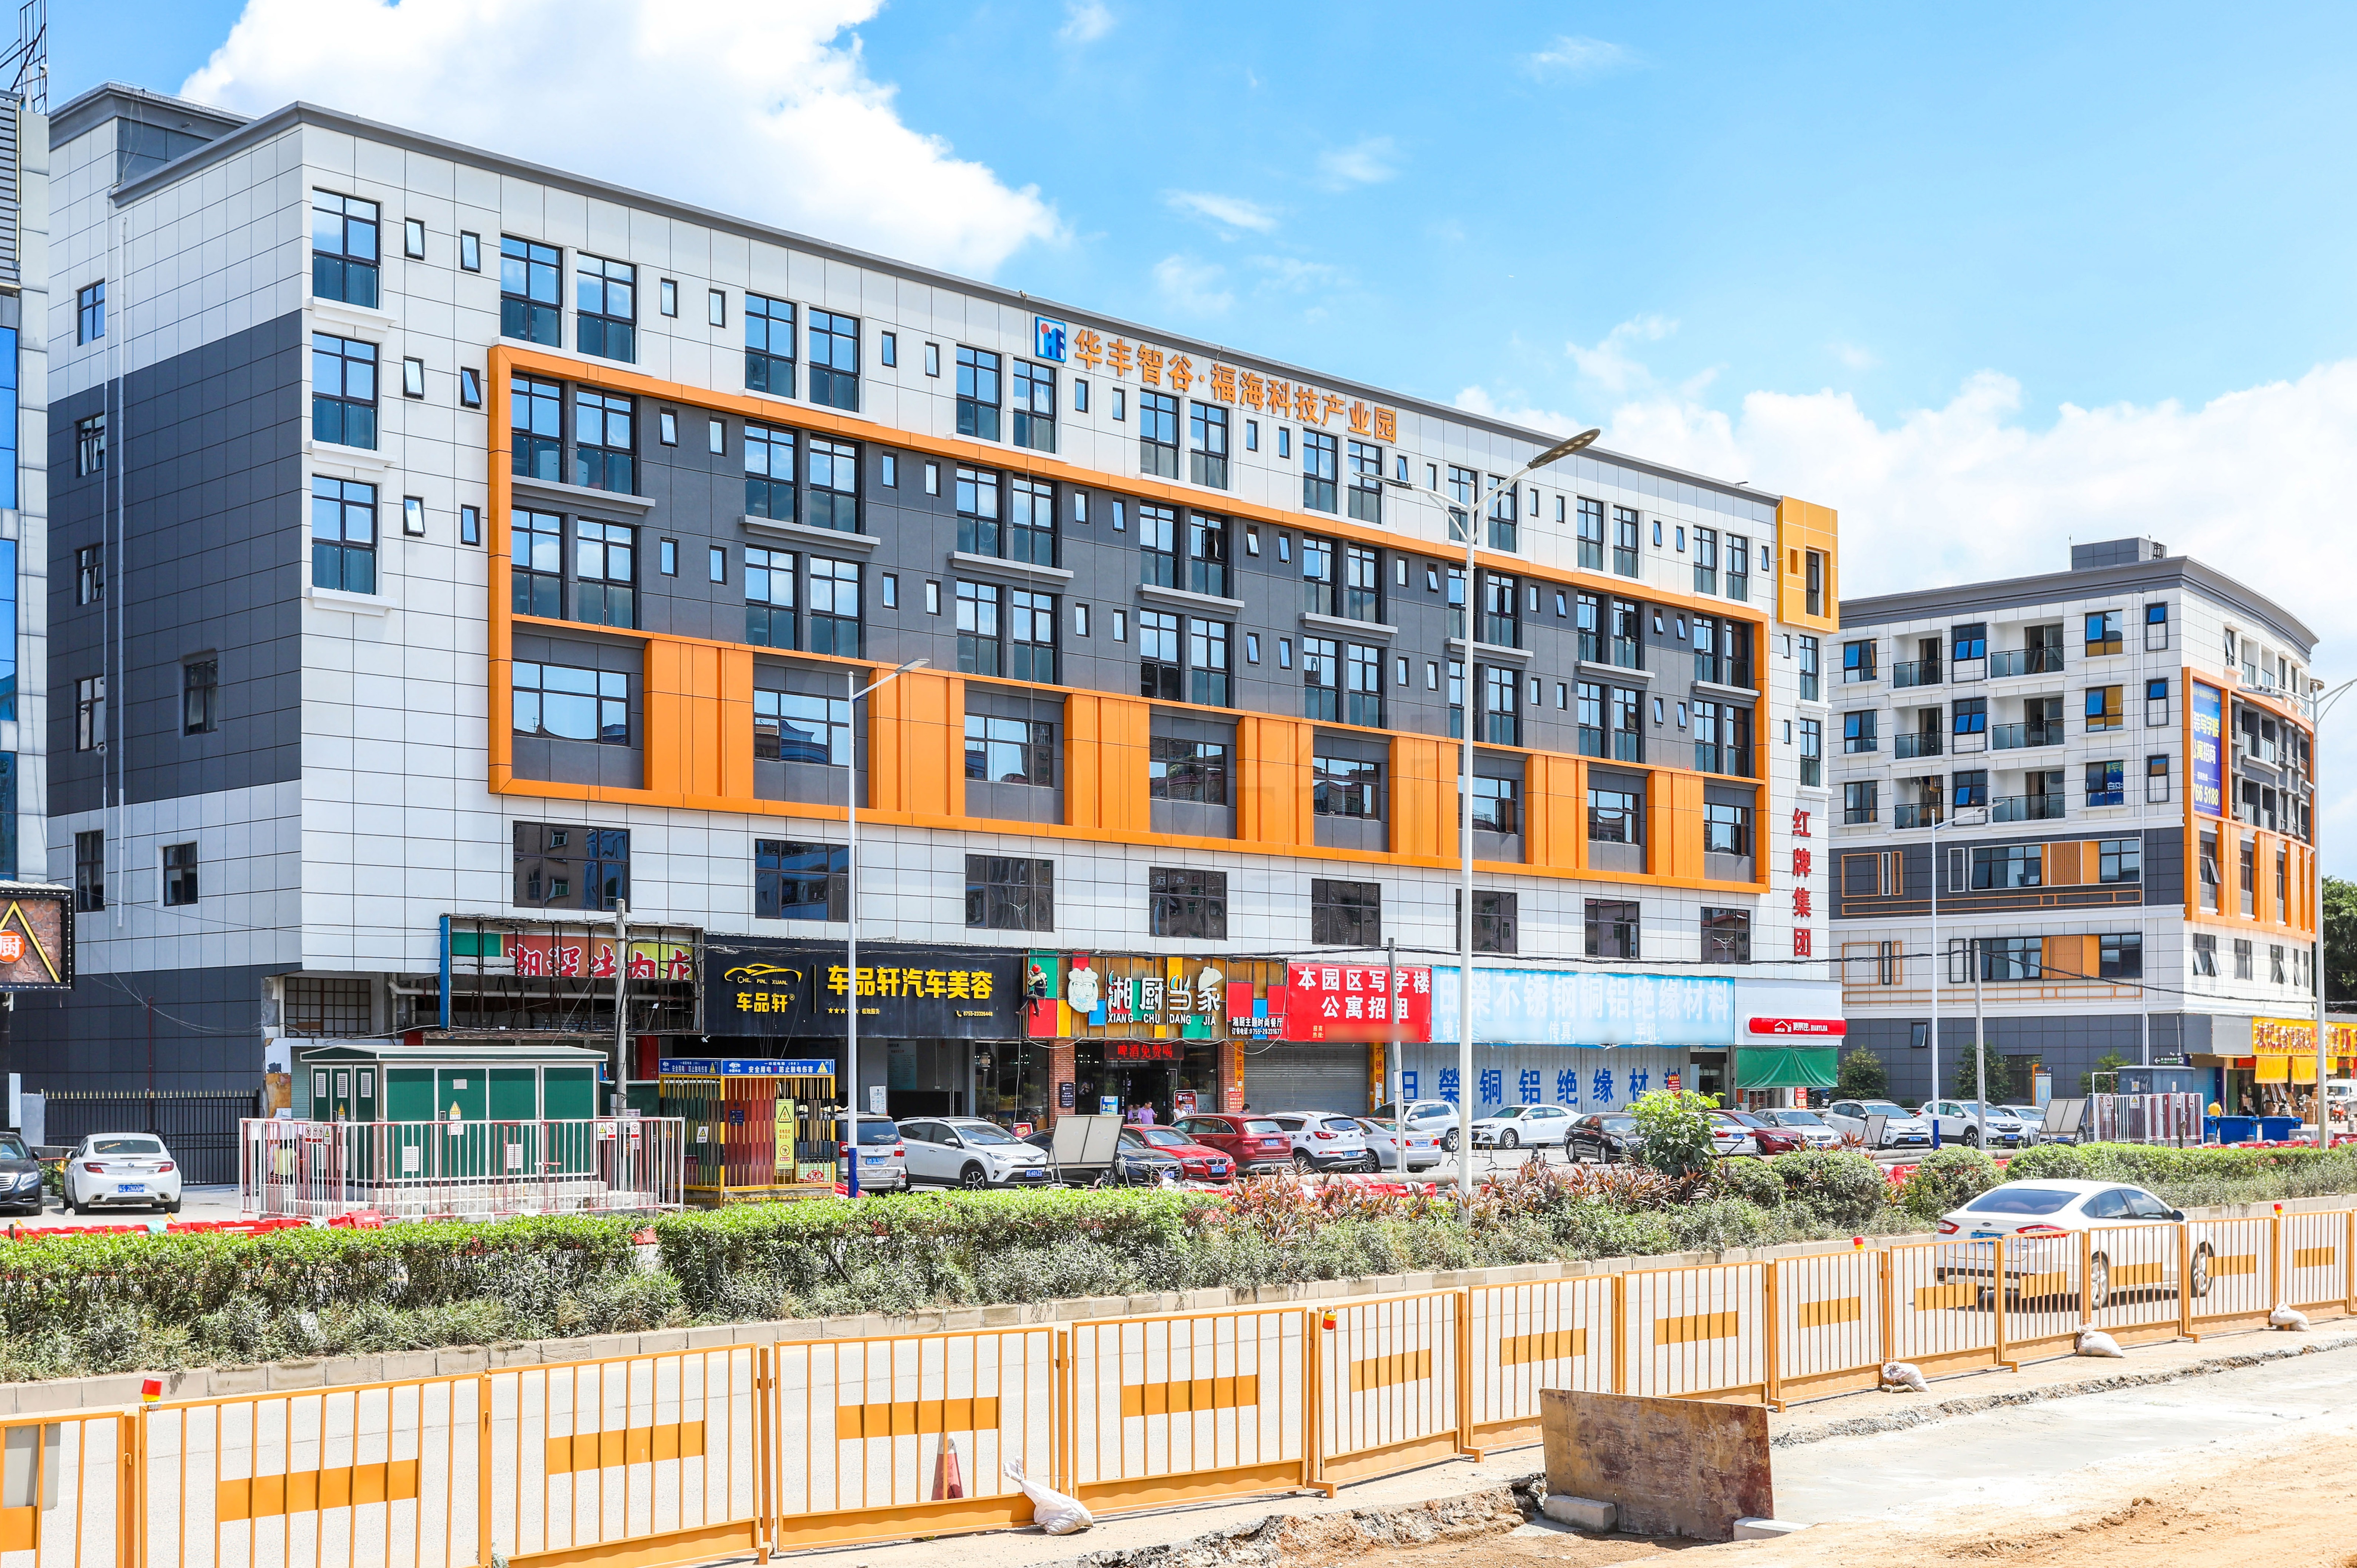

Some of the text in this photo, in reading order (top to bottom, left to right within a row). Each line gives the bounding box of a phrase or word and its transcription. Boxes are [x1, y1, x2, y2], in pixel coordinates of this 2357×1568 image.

[2204, 785, 2218, 806] 5188
[1793, 808, 1811, 957] 红牌集团
[827, 965, 993, 999] 车品轩汽车美容
[1107, 967, 1223, 1013] 湘厨当家
[1298, 967, 1430, 994] 本园区写字楼
[1107, 1013, 1216, 1026] XIANG CHU DANG JIA
[1232, 1017, 1283, 1027] 湘厨主题时尚餐厅
[1118, 1044, 1173, 1058] 啤酒免费喝
